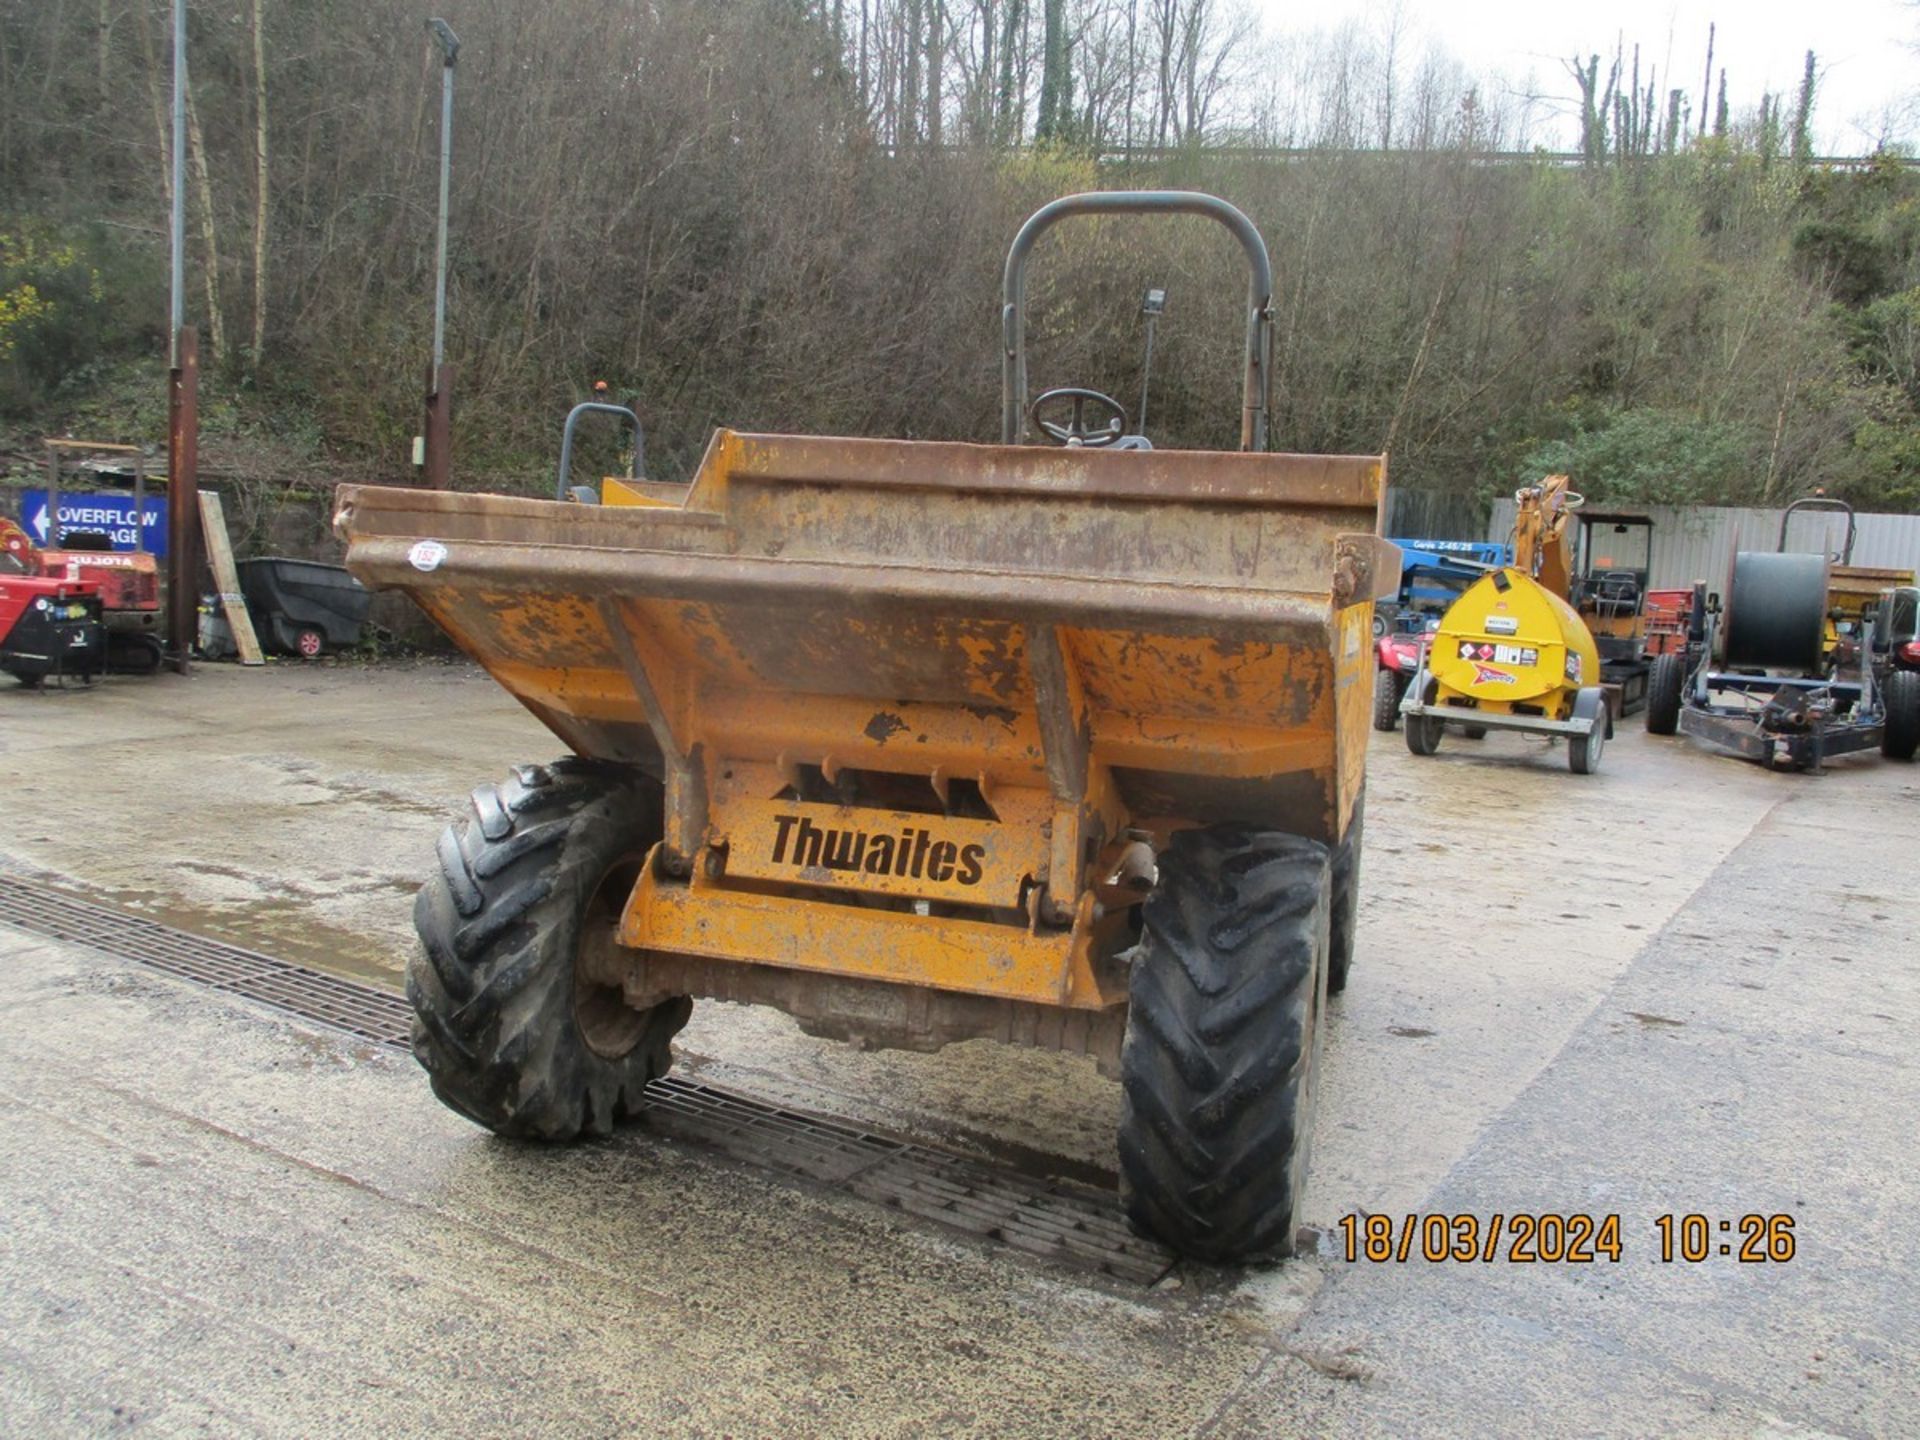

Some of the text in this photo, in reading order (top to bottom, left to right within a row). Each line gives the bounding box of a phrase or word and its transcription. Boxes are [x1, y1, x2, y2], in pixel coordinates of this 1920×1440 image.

[56, 506, 158, 527] OVERFLOW
[1413, 541, 1436, 550] Genie
[1481, 670, 1516, 684] Speedy
[771, 814, 985, 886] Thwaites
